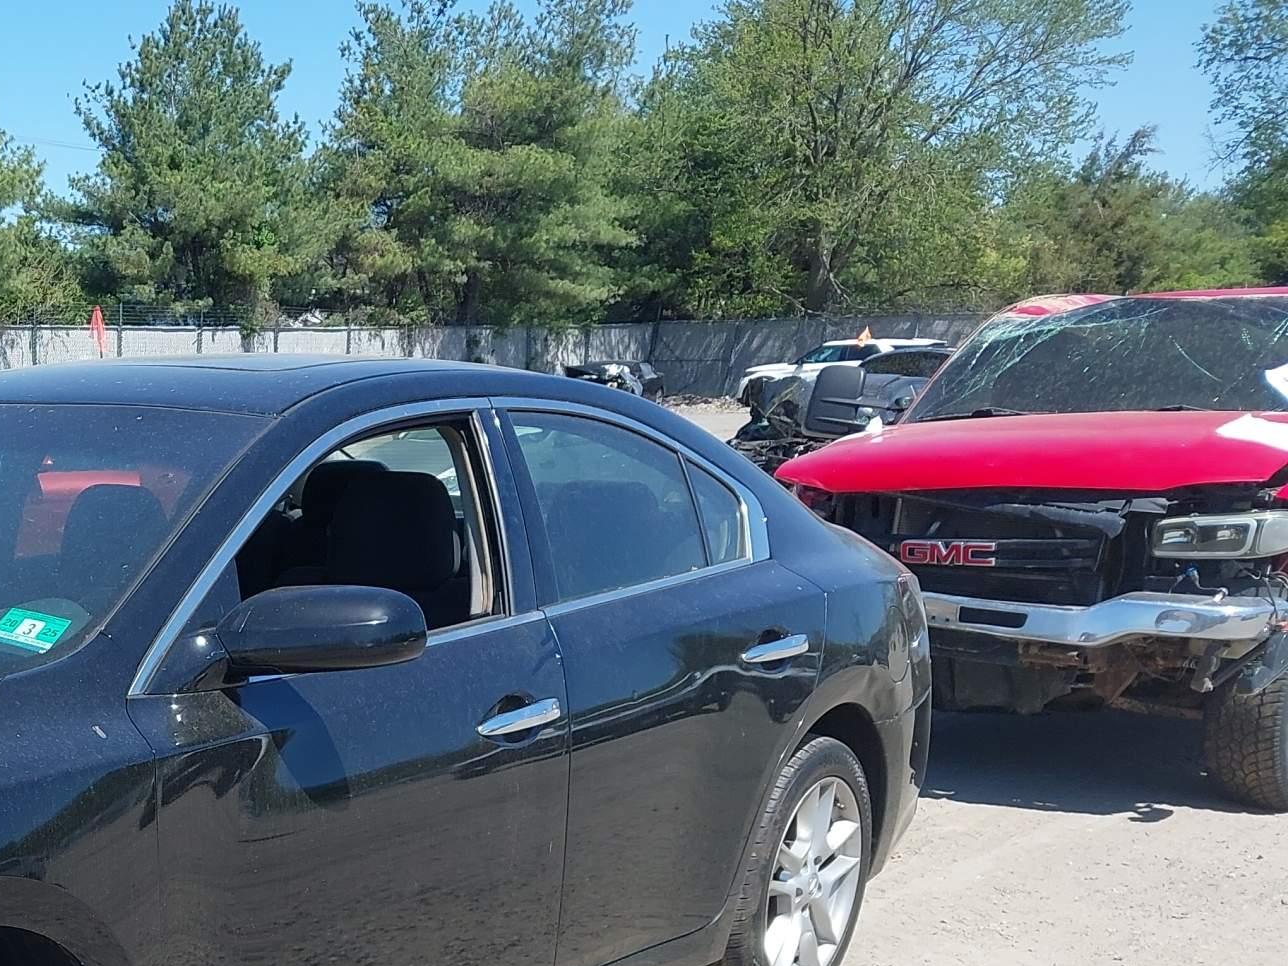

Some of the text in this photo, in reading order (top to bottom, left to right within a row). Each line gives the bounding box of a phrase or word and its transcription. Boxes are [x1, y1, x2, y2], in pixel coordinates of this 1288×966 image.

[900, 540, 996, 567] GMC
[2, 618, 18, 628] 20
[22, 623, 37, 636] 3
[41, 627, 60, 638] 25
